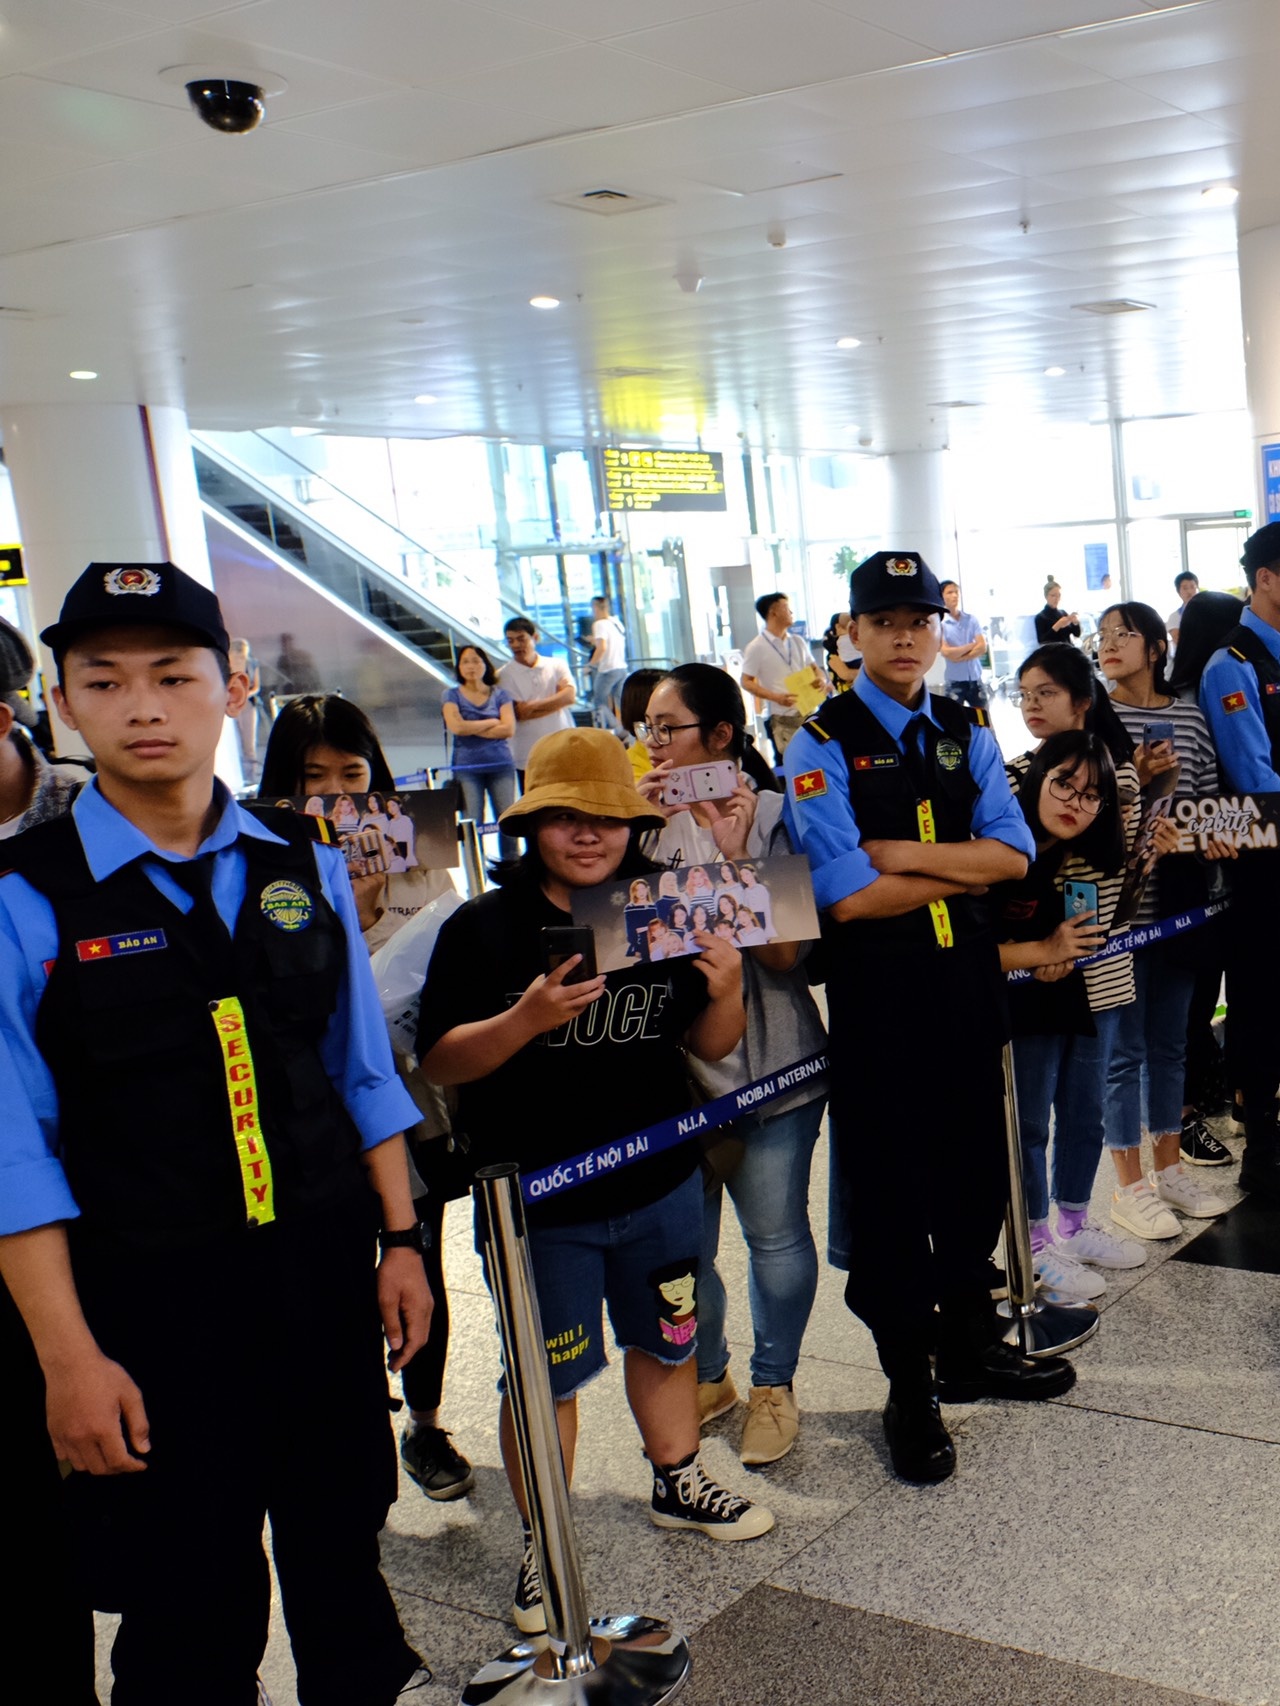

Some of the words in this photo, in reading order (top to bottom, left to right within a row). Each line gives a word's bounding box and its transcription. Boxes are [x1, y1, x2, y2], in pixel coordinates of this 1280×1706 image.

[1171, 796, 1262, 824] OONA
[118, 937, 140, 949] BẢO
[143, 936, 158, 946] AN
[1124, 932, 1134, 948] TẾ
[219, 1013, 268, 1203] SECURITY
[529, 1165, 574, 1197] QUỐC
[576, 1152, 594, 1178] TẾ
[597, 1147, 622, 1168] NỘI
[736, 1080, 775, 1109] NOIBAI
[551, 1335, 591, 1365] happy
